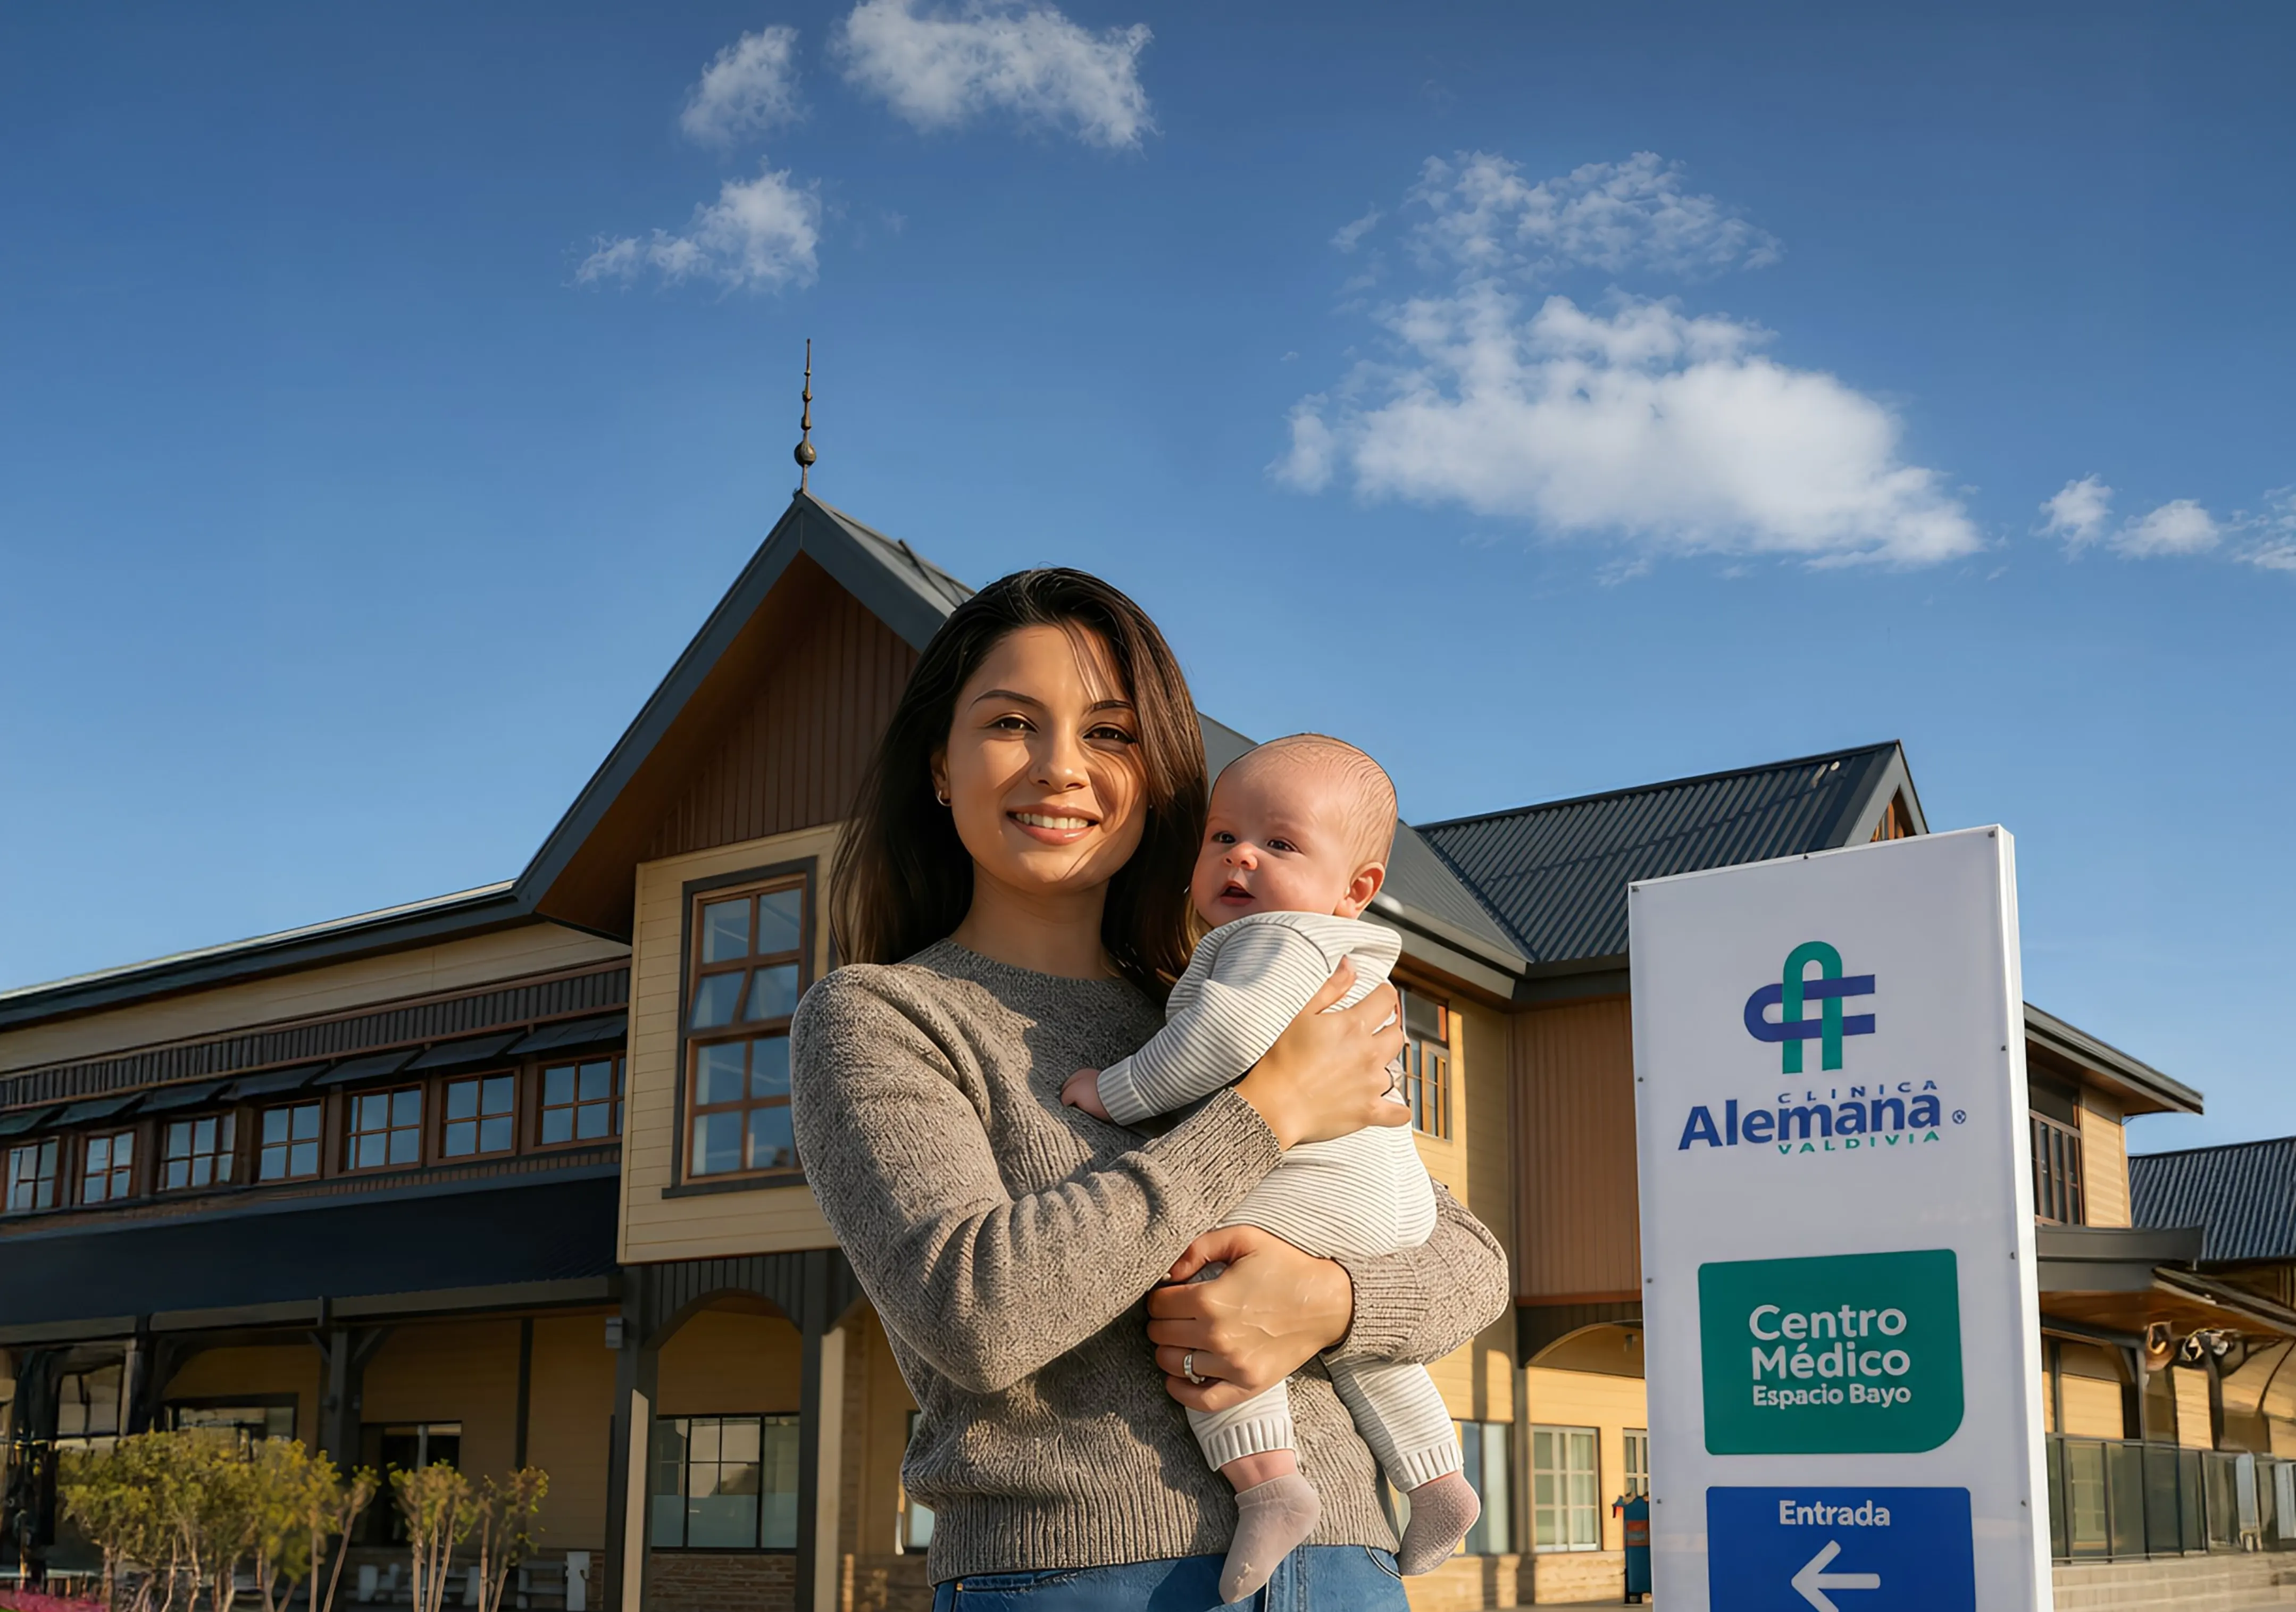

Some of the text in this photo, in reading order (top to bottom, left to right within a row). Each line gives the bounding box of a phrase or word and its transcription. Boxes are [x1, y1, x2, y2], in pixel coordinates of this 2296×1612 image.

[1777, 1080, 1938, 1104] CLINICA
[1677, 1094, 1941, 1151] Alemana
[1778, 1130, 1940, 1155] VALDIVIA
[1749, 1305, 1907, 1341] Centro
[1751, 1341, 1910, 1380] Médico
[1753, 1383, 1911, 1410] Espacio Bayo
[1780, 1500, 1891, 1527] Entrada
